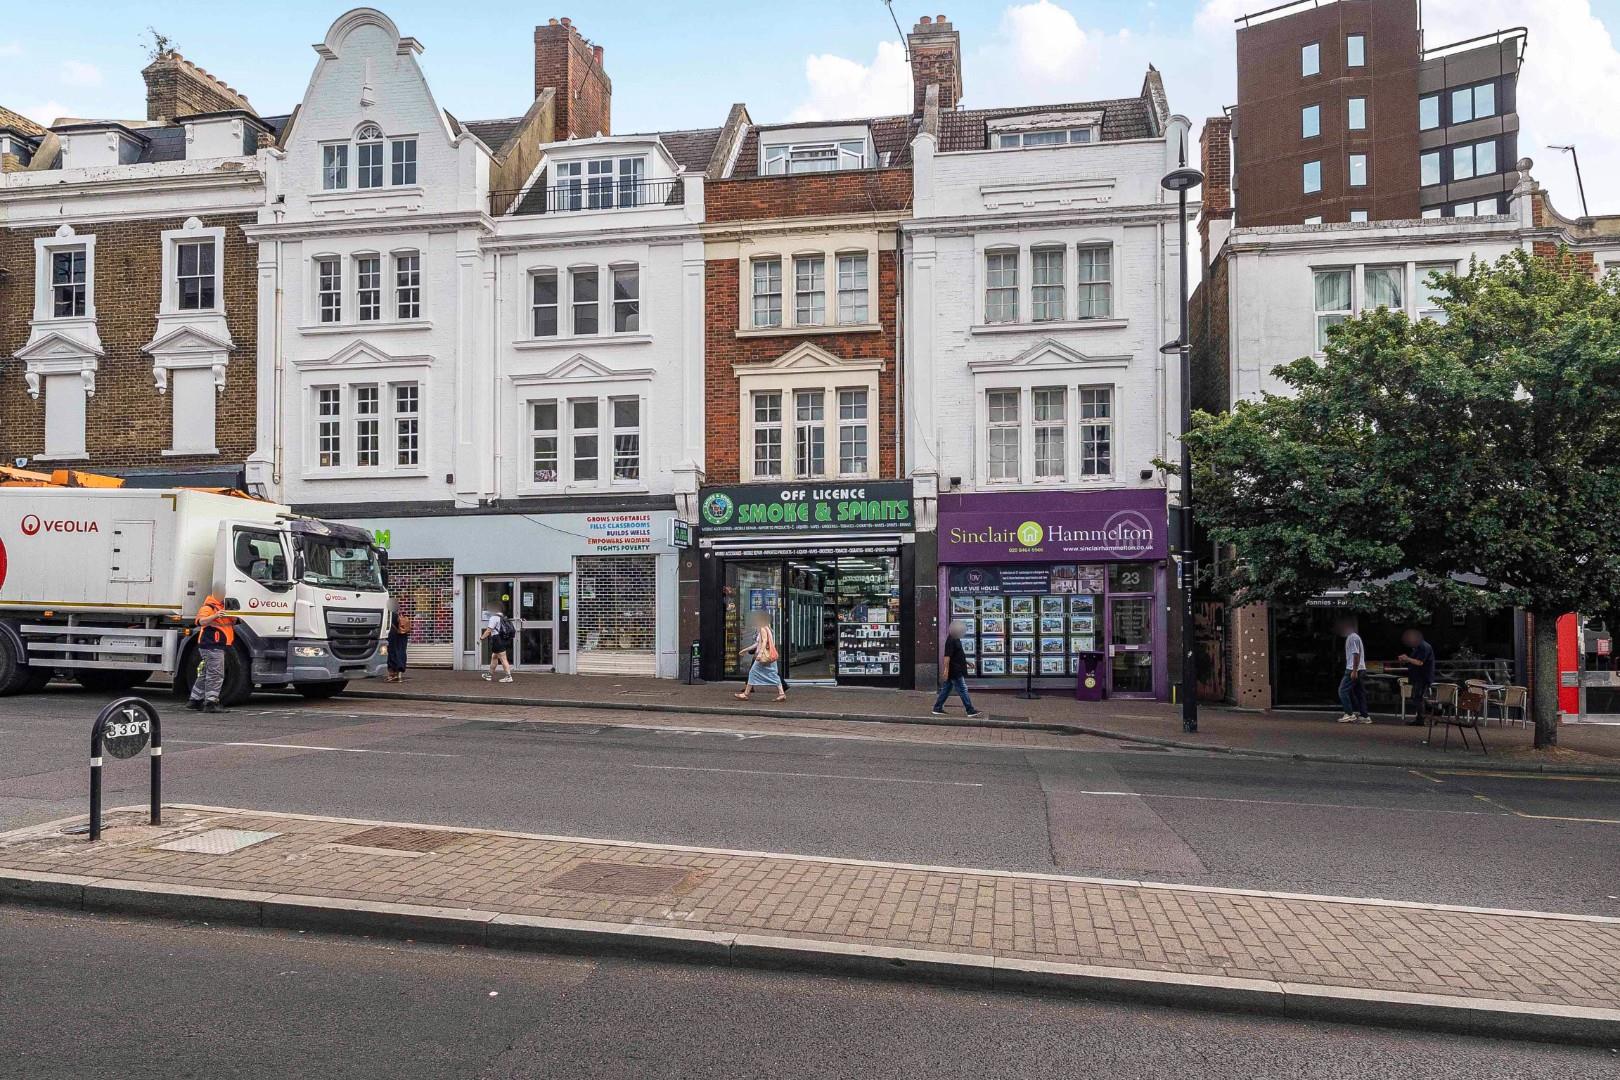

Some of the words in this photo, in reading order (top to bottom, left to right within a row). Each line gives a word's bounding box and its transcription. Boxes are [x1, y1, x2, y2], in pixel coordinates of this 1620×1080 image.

[781, 490, 806, 501] OFF
[812, 488, 866, 500] LICENCE
[738, 502, 809, 523] SMOKE
[815, 502, 832, 521] &
[837, 500, 910, 521] SPIRITS
[44, 520, 99, 533] VEOLIA
[371, 529, 390, 549] M
[950, 526, 1016, 544] Sinclair
[1048, 523, 1153, 542] Hammelton
[1121, 572, 1140, 585] 23
[260, 600, 289, 608] VEOLIA
